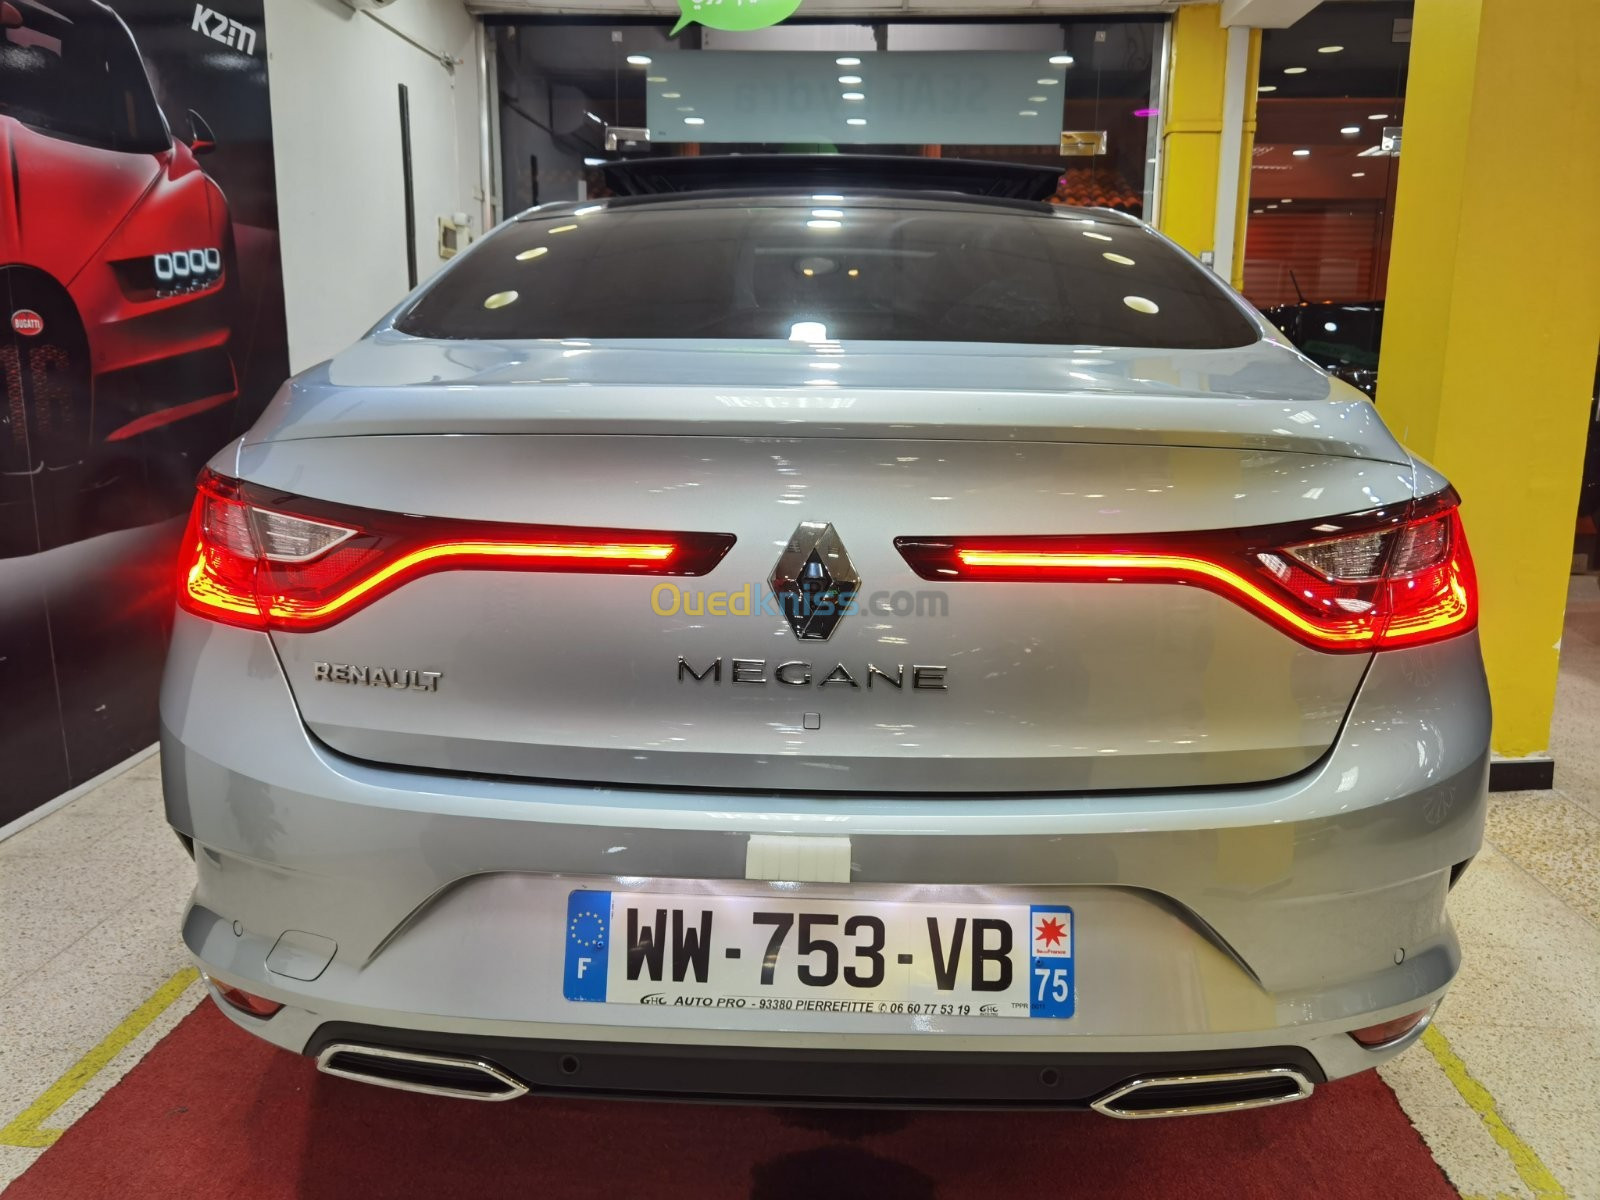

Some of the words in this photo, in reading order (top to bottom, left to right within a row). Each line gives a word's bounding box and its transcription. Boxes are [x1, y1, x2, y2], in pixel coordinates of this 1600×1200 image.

[14, 318, 41, 330] BUGATTI
[313, 661, 442, 692] RENAULT
[677, 655, 949, 690] MEGANE
[577, 957, 591, 979] F
[1034, 968, 1069, 1003] 75
[673, 995, 713, 1007] AUTO
[716, 997, 746, 1009] PRO
[759, 998, 793, 1011] 93380
[795, 1000, 874, 1013] PIERREFITTE
[890, 1002, 904, 1014] 06
[907, 1003, 921, 1014] 60
[924, 1003, 937, 1015] 77
[940, 1004, 953, 1015] 53
[958, 1004, 971, 1016] 19
